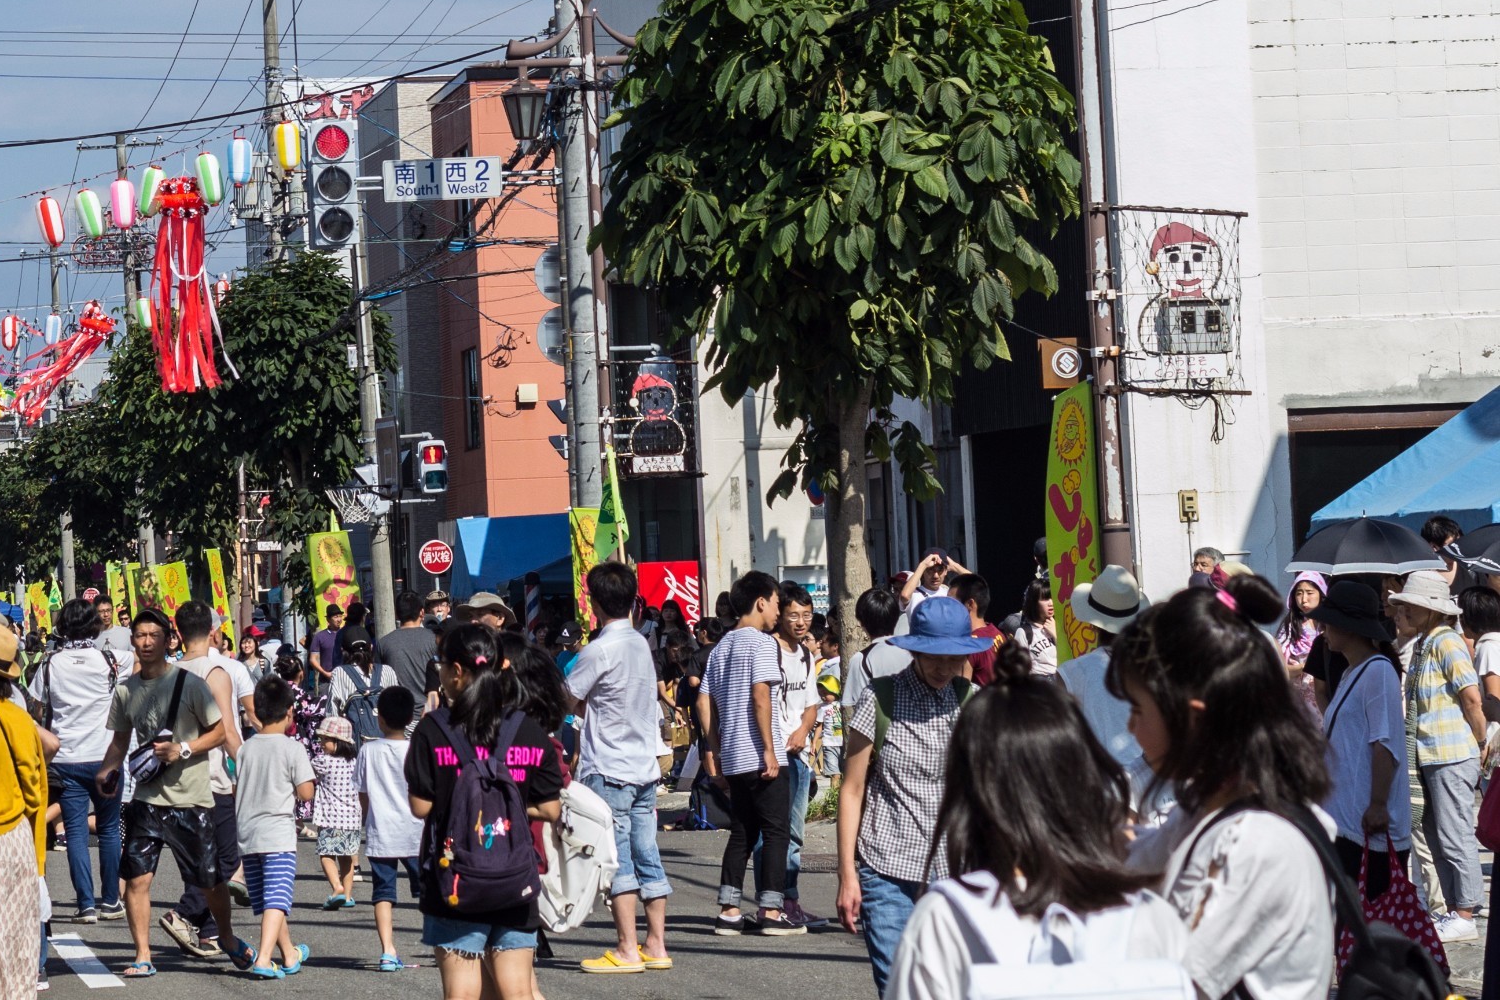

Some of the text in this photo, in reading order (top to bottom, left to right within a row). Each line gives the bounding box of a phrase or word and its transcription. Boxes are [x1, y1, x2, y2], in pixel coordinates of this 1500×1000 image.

[394, 160, 490, 185] 南 1 西 2
[396, 183, 488, 197] South1 West2
[423, 551, 450, 564] 消火栓
